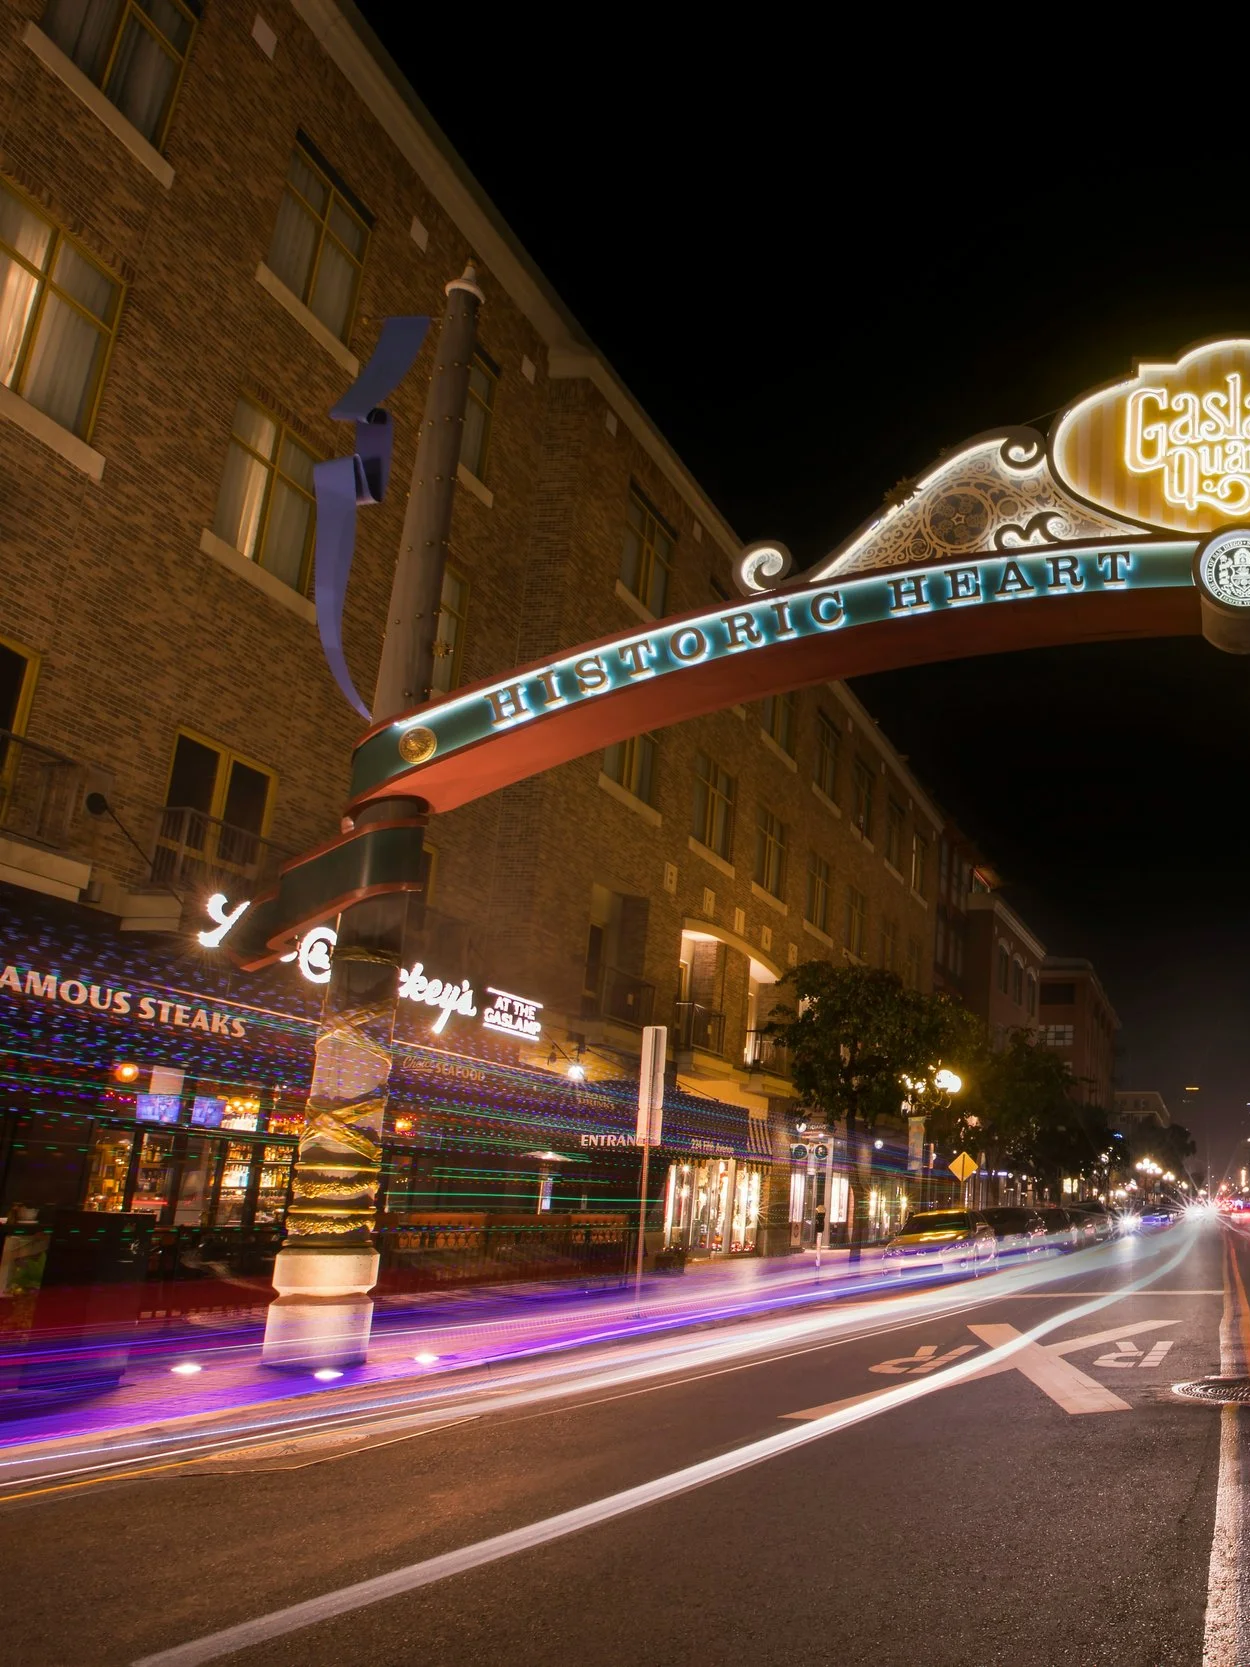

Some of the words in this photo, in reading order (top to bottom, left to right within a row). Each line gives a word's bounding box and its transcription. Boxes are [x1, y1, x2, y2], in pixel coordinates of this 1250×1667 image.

[491, 591, 846, 728] HISTORIC
[888, 551, 1132, 614] HEART
[0, 966, 131, 1014] AMOUS
[138, 997, 248, 1038] STEAKS
[494, 996, 512, 1011] AT
[513, 1001, 536, 1020] THE
[484, 1007, 541, 1036] GASLAMP
[436, 1063, 485, 1082] SEAFOOD
[580, 1134, 637, 1147] ENTRAN
